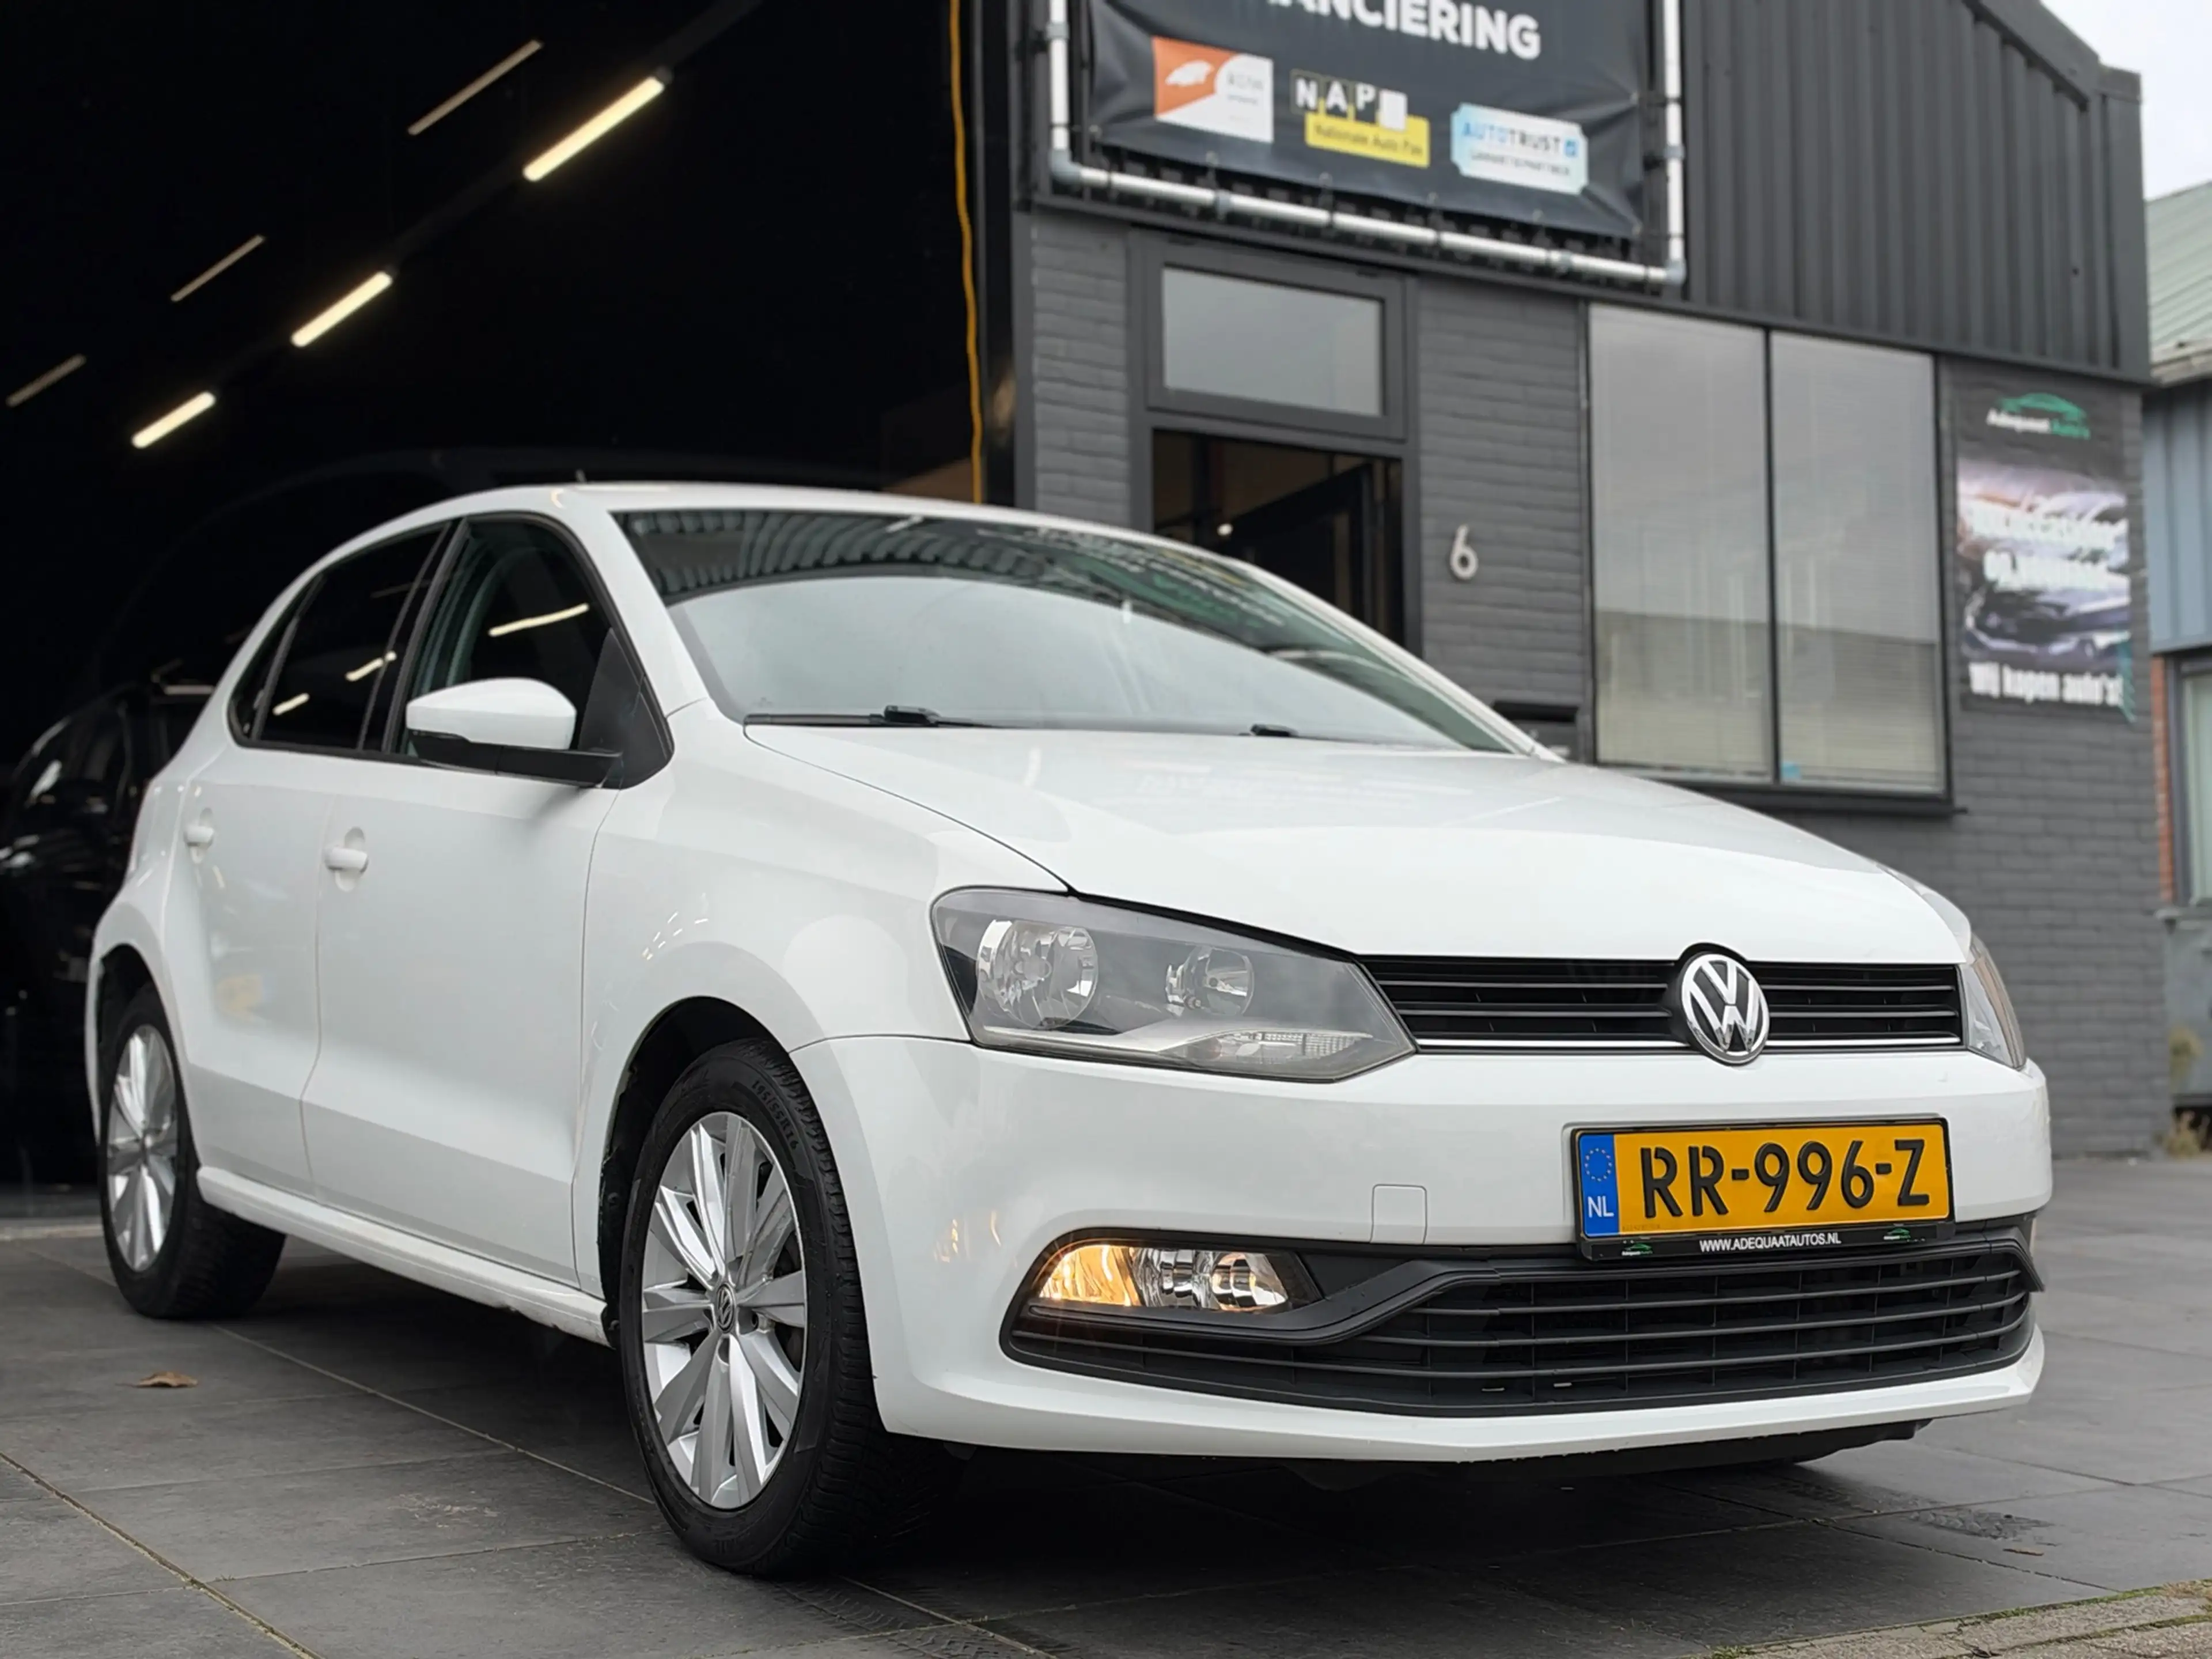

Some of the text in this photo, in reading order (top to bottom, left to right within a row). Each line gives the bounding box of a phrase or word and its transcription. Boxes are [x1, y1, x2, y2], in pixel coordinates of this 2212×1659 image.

[1296, 77, 1377, 111] NAP
[1449, 523, 1479, 580] 6
[1640, 1139, 1930, 1219] RR-996-Z
[1588, 1196, 1614, 1218] NL
[1699, 1232, 1842, 1253] WWW.ADEQUAATAUTOS.NL
